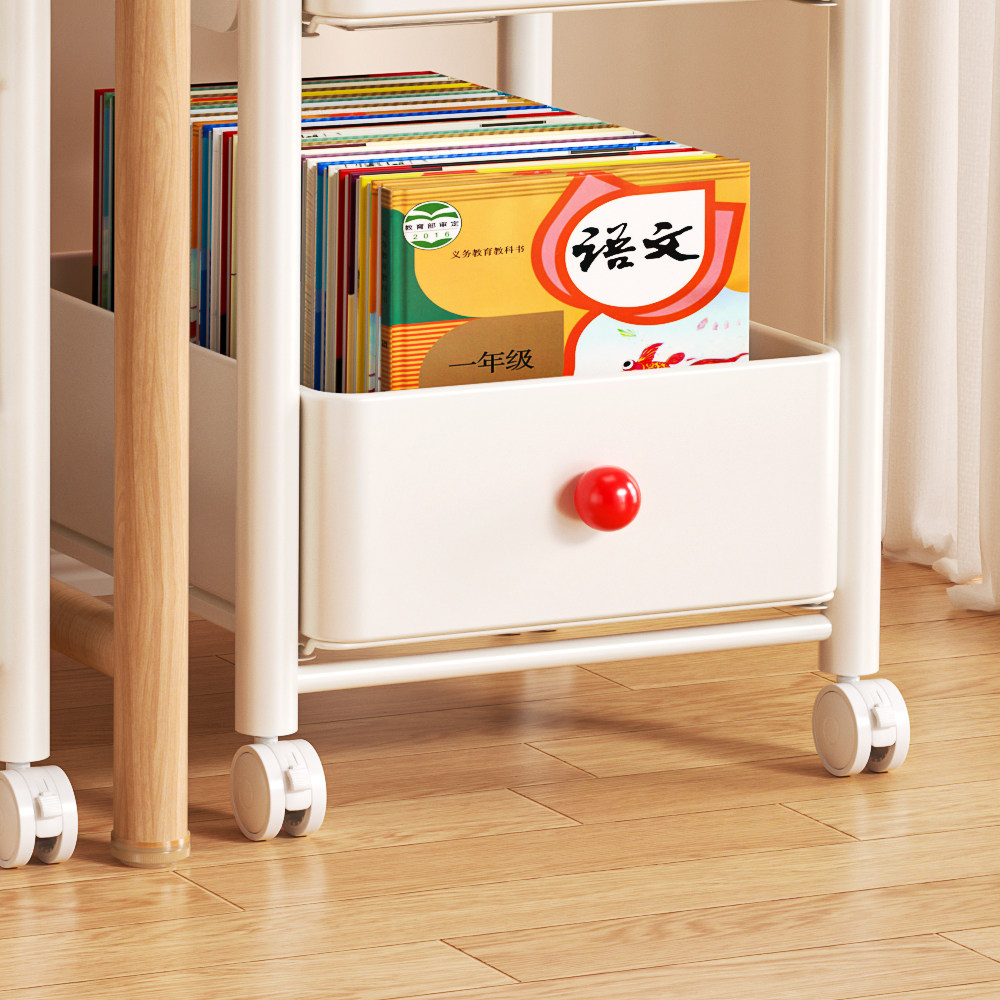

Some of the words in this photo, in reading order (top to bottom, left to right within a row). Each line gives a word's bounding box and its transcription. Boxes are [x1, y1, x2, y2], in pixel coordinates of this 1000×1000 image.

[404, 219, 459, 231] 教育部审定
[413, 231, 450, 240] 2016
[450, 243, 526, 260] 义务教育教科书
[571, 221, 700, 273] 语文
[448, 348, 535, 374] 一年级
